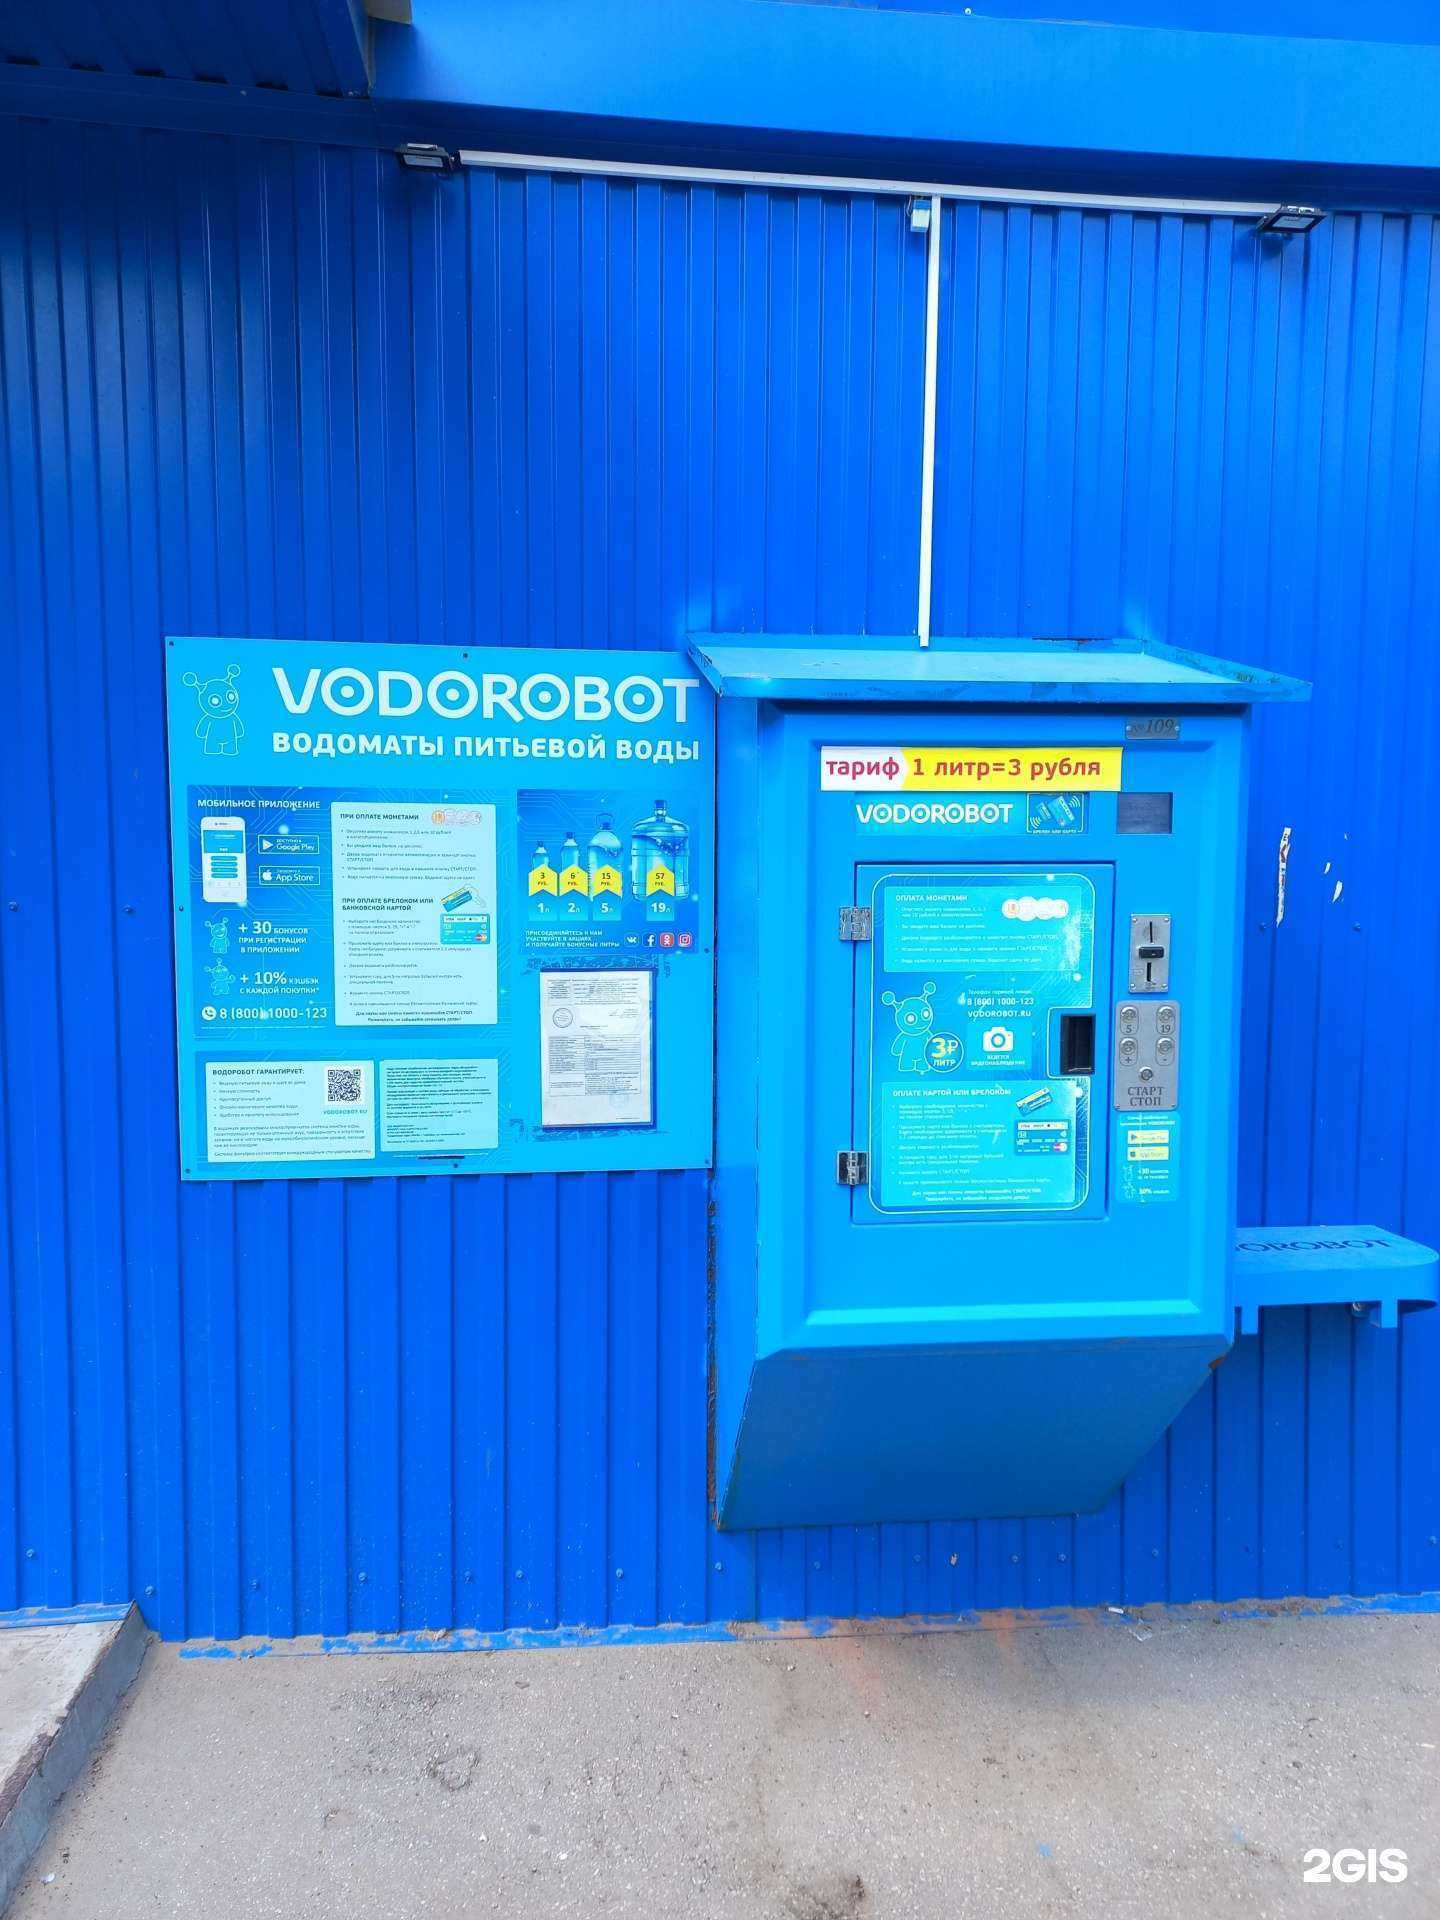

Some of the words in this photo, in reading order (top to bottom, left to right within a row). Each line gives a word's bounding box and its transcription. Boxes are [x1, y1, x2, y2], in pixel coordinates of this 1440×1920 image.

[272, 667, 700, 723] VODOROBOT
[272, 732, 444, 758] ВОДОМАТЫ
[454, 733, 606, 760] ПИТЬЕВОЙ
[615, 739, 699, 764] ВОДЫ
[826, 757, 900, 780] тариф
[913, 758, 925, 776] 1
[934, 758, 1022, 780] литр=3
[1030, 757, 1101, 780] рубля
[197, 799, 256, 808] МОБИЛЬНОЕ
[258, 800, 321, 809] ПРИЛОЖЕНИЕ
[856, 803, 1013, 824] VODOROBOT
[276, 843, 299, 852] Google
[301, 843, 315, 852] Play
[276, 874, 293, 884] App
[294, 874, 314, 882] Store
[602, 872, 611, 880] 15
[655, 872, 665, 880] 57
[896, 894, 924, 902] ОПЛАТА
[926, 894, 968, 902] МОНЕТАМИ
[252, 920, 272, 935] 30
[274, 927, 308, 935] БОНУСОВ
[255, 937, 307, 945] РЕГИСТРАЦИИ
[254, 971, 287, 985] 10%
[246, 985, 280, 995] КАЖДОЙ
[998, 997, 1034, 1005] 1000-123
[219, 1008, 228, 1019] 8
[231, 1007, 266, 1020] (800)
[267, 1007, 328, 1019] 1000-123
[968, 1010, 1031, 1018] VODOROBOT.RU
[1125, 1025, 1132, 1034] 5
[1161, 1024, 1171, 1033] 19
[933, 1059, 956, 1067] ЛИТР
[922, 1088, 952, 1097] КАРТОЙ
[1127, 1086, 1165, 1096] СТАРТ
[1130, 1097, 1162, 1107] СТОП
